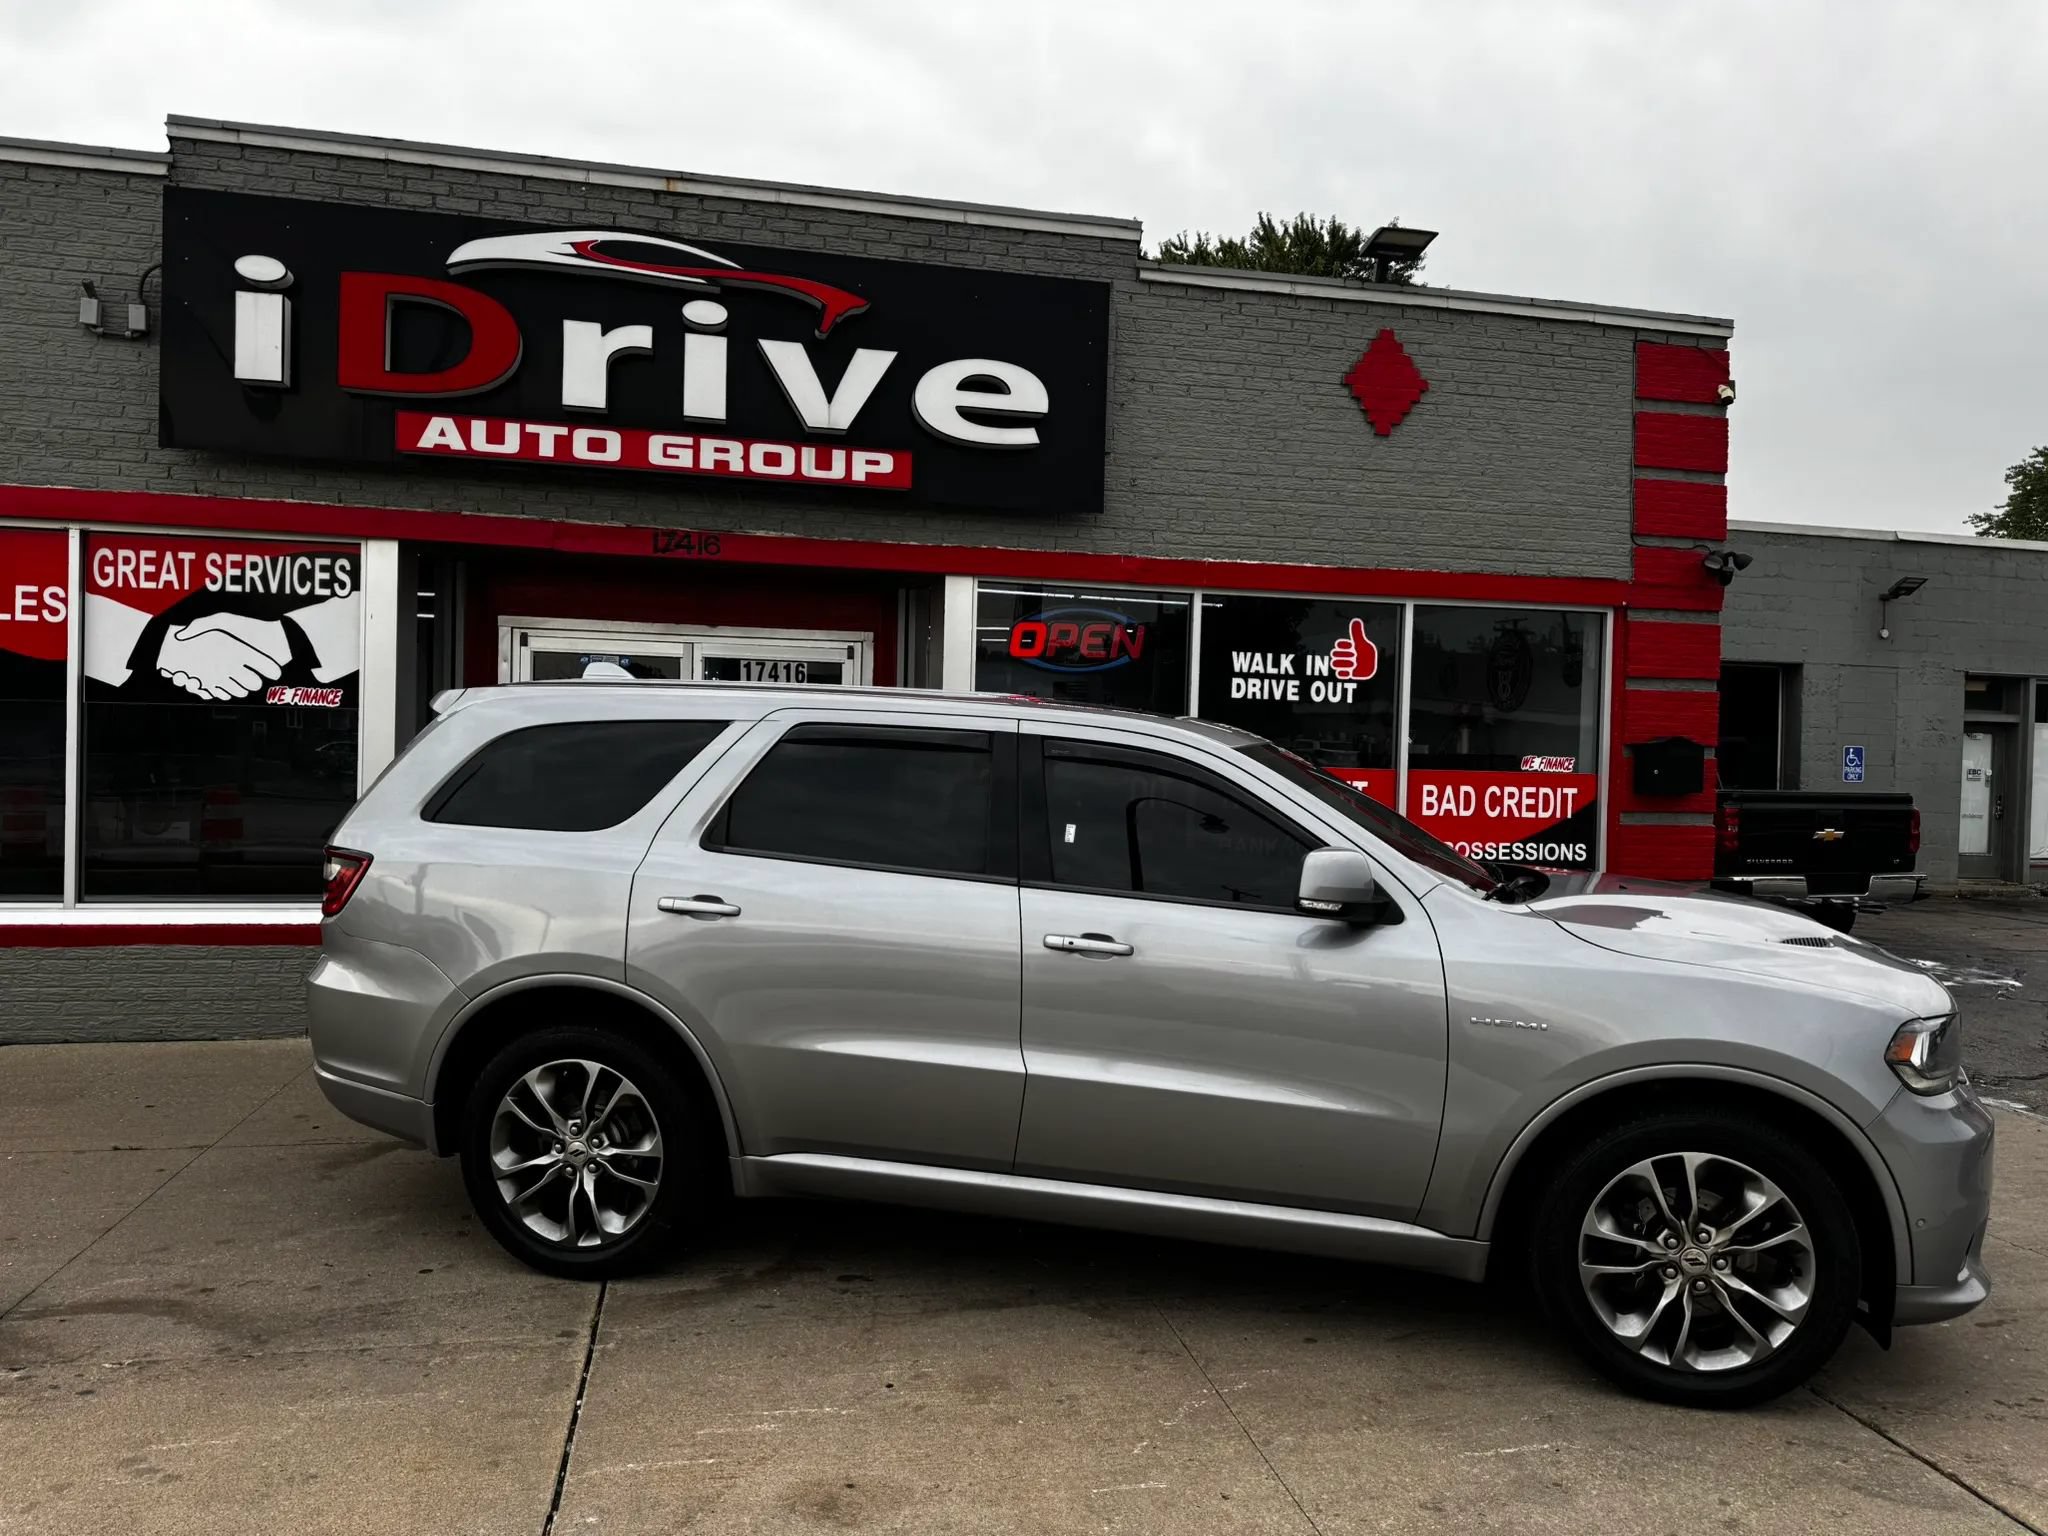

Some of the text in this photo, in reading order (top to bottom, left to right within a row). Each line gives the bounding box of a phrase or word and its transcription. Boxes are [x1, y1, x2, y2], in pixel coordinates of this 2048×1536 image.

[416, 416, 894, 481] AUTO GROUP
[653, 530, 720, 555] 17416
[93, 548, 352, 598] GREAT SERVICES
[1009, 621, 1145, 660] OPEN
[743, 661, 806, 683] 17416
[1232, 651, 1329, 677] WALK IN
[266, 686, 343, 707] WE FINANCE
[1231, 678, 1357, 704] DRIVE OUT
[1521, 755, 1576, 773] WE FINANCE
[1421, 784, 1578, 819] BAD CREDIT
[1444, 841, 1587, 862] OSSESSIONS
